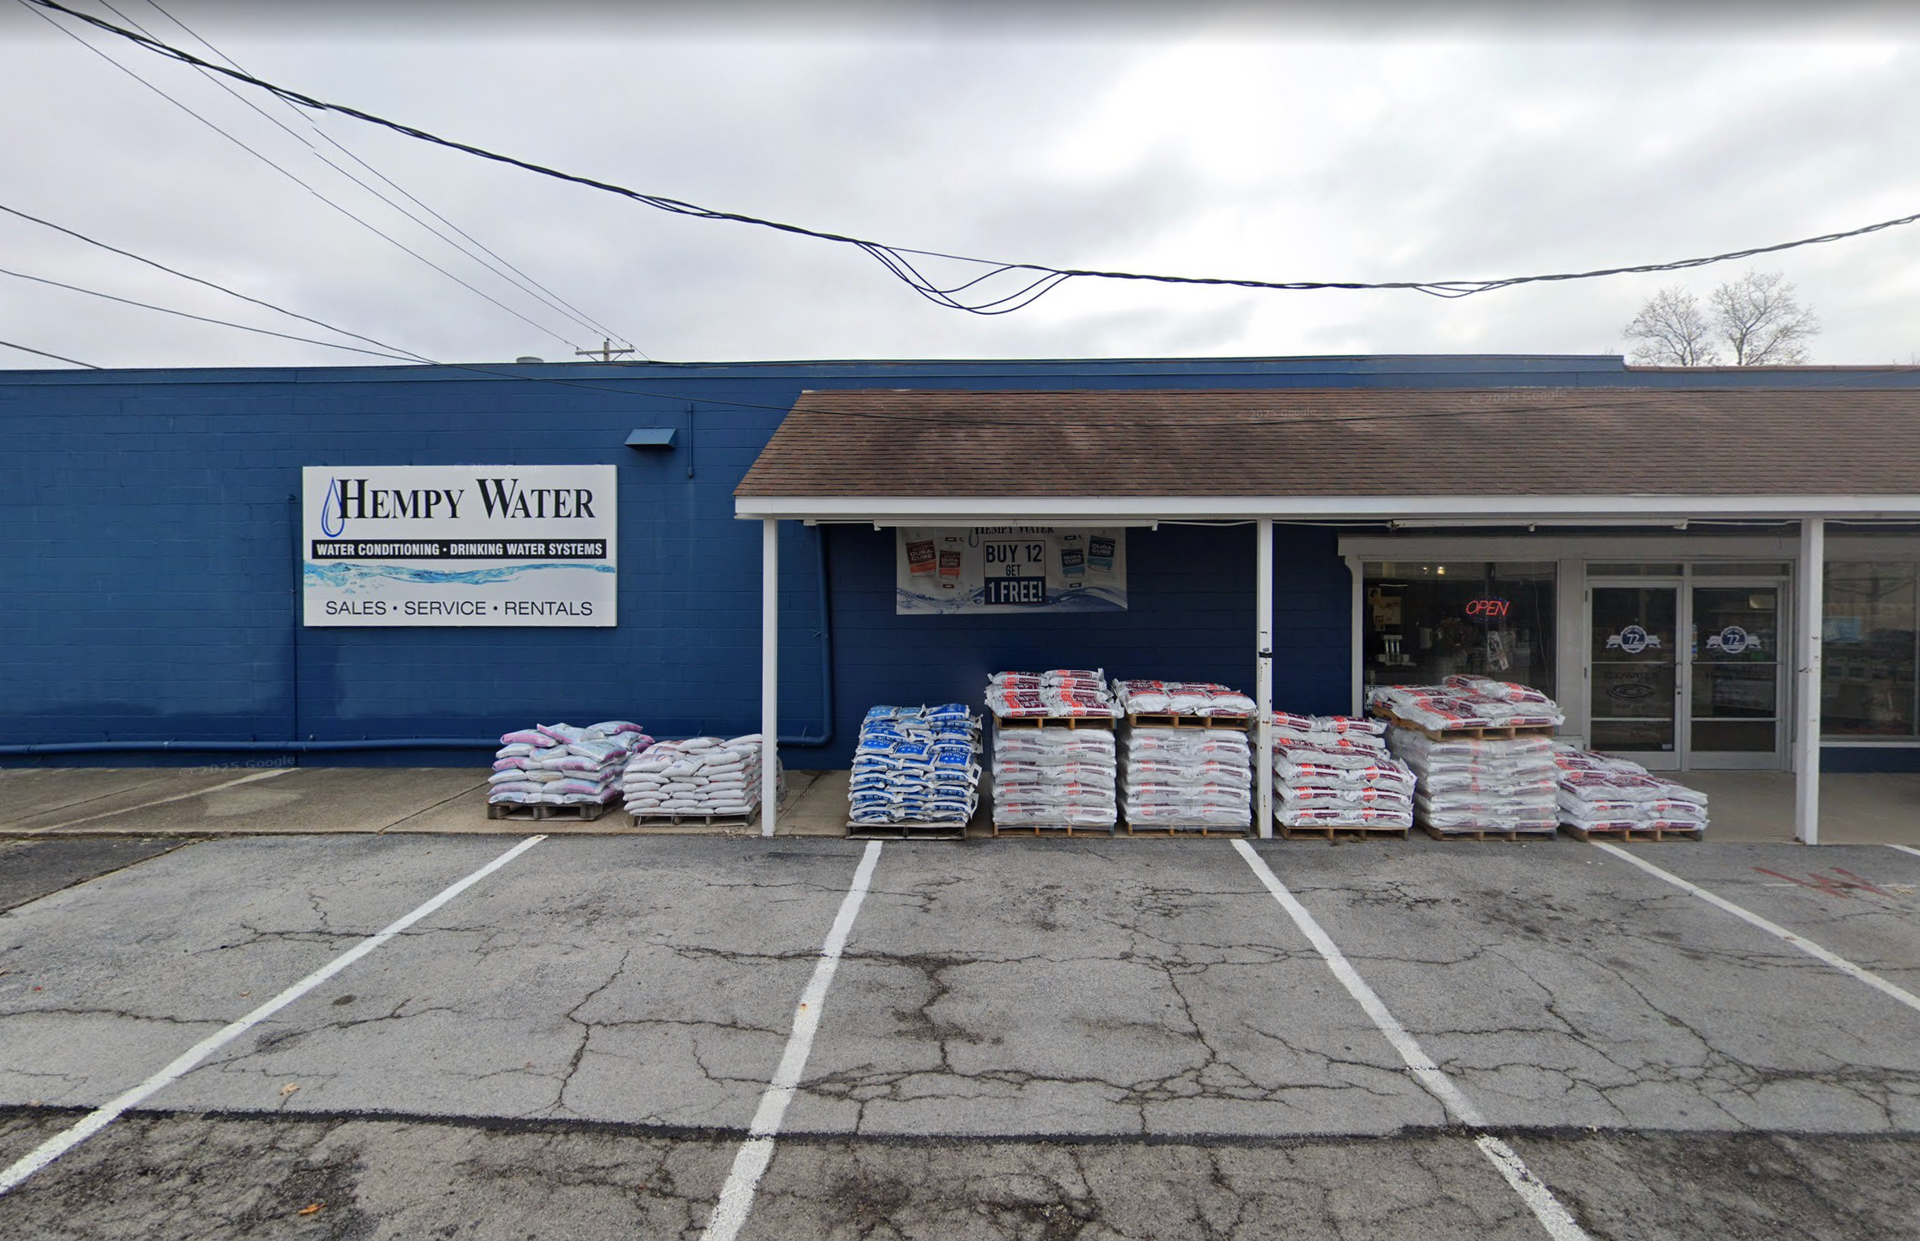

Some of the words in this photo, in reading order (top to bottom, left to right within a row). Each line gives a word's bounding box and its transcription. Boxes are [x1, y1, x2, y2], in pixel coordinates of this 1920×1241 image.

[476, 478, 596, 519] WATER
[316, 544, 355, 556] WATER
[358, 543, 440, 556] CONDITIONING
[450, 543, 503, 556] DRINKING
[507, 543, 545, 556] WATER
[548, 543, 603, 556] SYSTEMS
[986, 545, 1018, 563] BUY
[1025, 544, 1042, 562] 12
[1005, 564, 1021, 576] GET
[989, 581, 995, 602] 1
[1001, 581, 1042, 602] FREE!
[325, 600, 387, 616] SALES
[404, 600, 487, 616] SERVICE
[504, 600, 593, 616] RENTALS
[1465, 600, 1509, 616] OPEN
[1627, 634, 1640, 645] 72
[1727, 634, 1740, 645] 72
